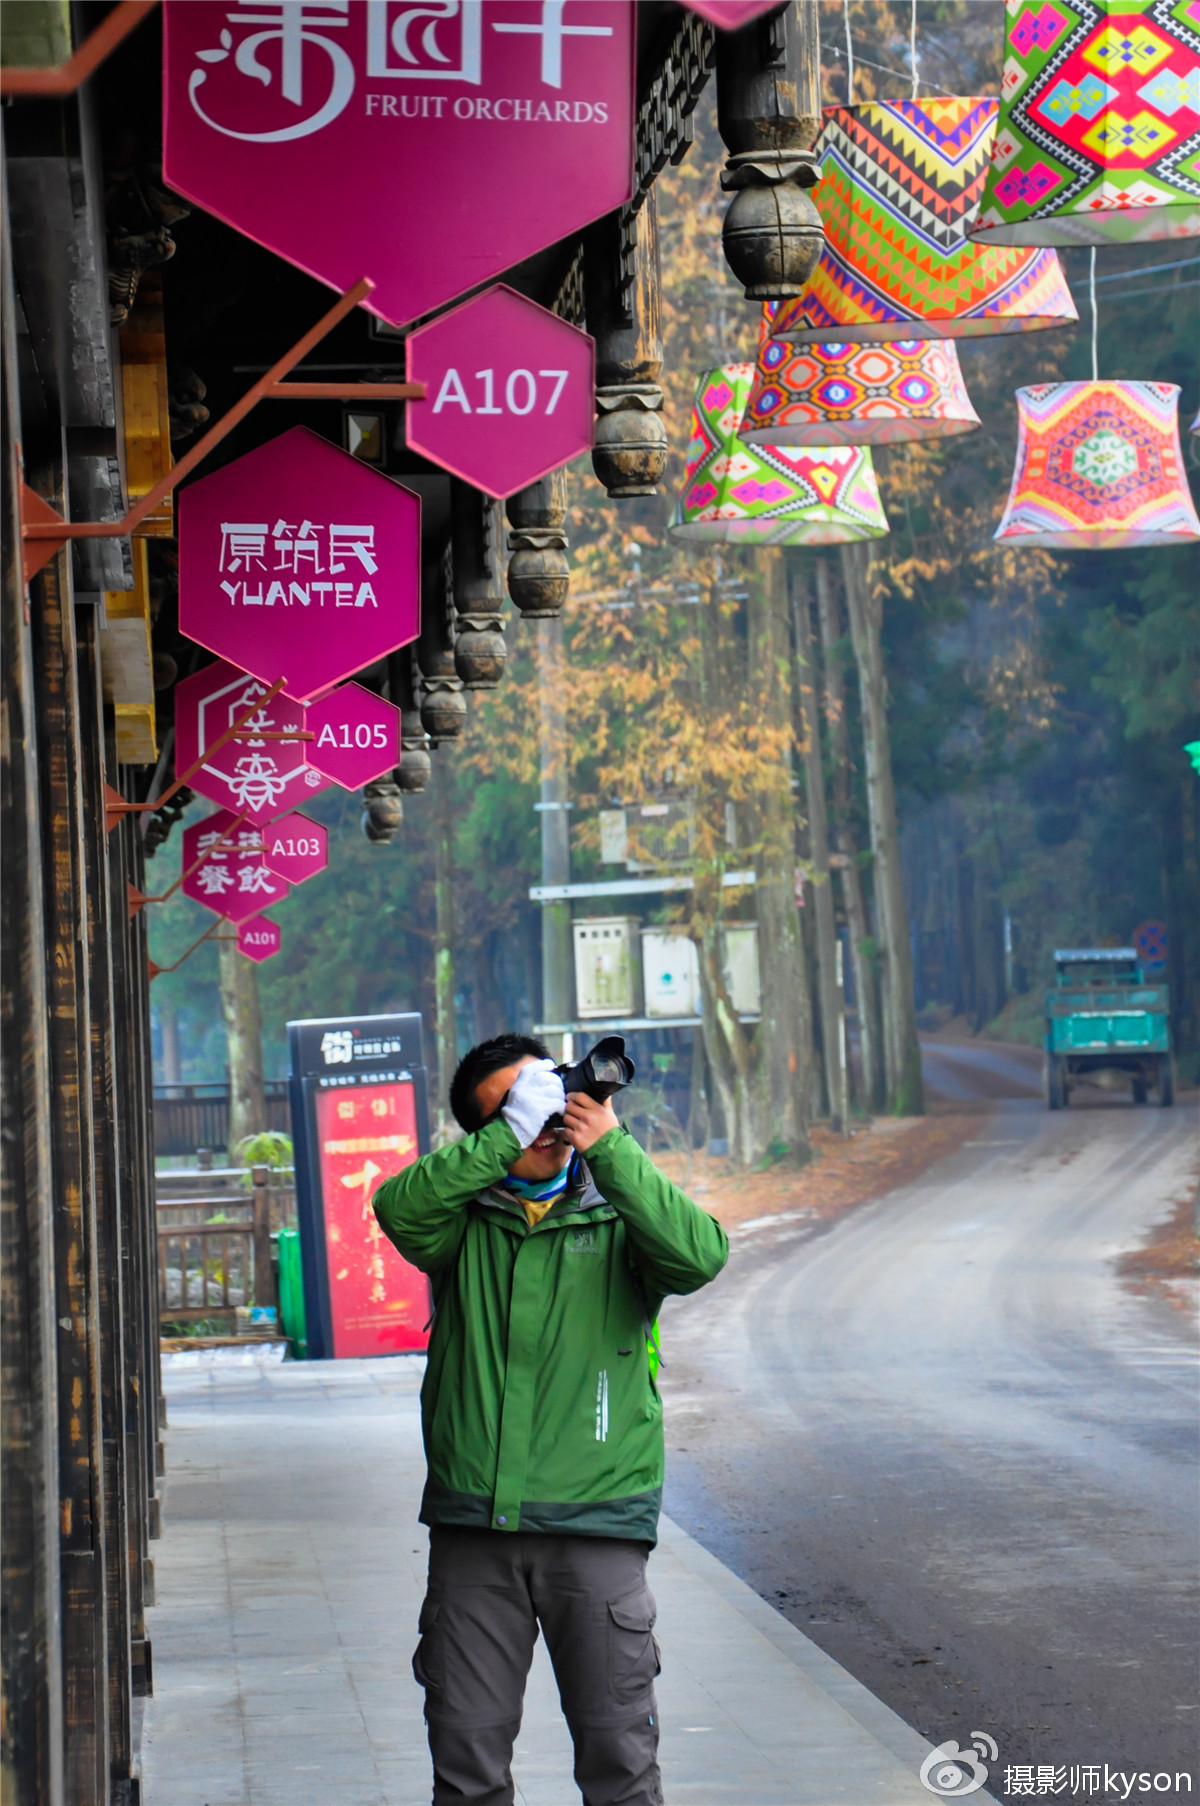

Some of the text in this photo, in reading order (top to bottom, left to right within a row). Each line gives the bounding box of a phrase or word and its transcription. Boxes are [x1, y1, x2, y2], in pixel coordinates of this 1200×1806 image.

[364, 94, 609, 124] FRUIT ORCHARDS
[431, 367, 569, 416] A107
[219, 518, 378, 576] 原筑民
[219, 579, 378, 608] YUANTEA
[316, 723, 388, 749] A105
[271, 838, 320, 857] A103
[243, 932, 276, 945] A101
